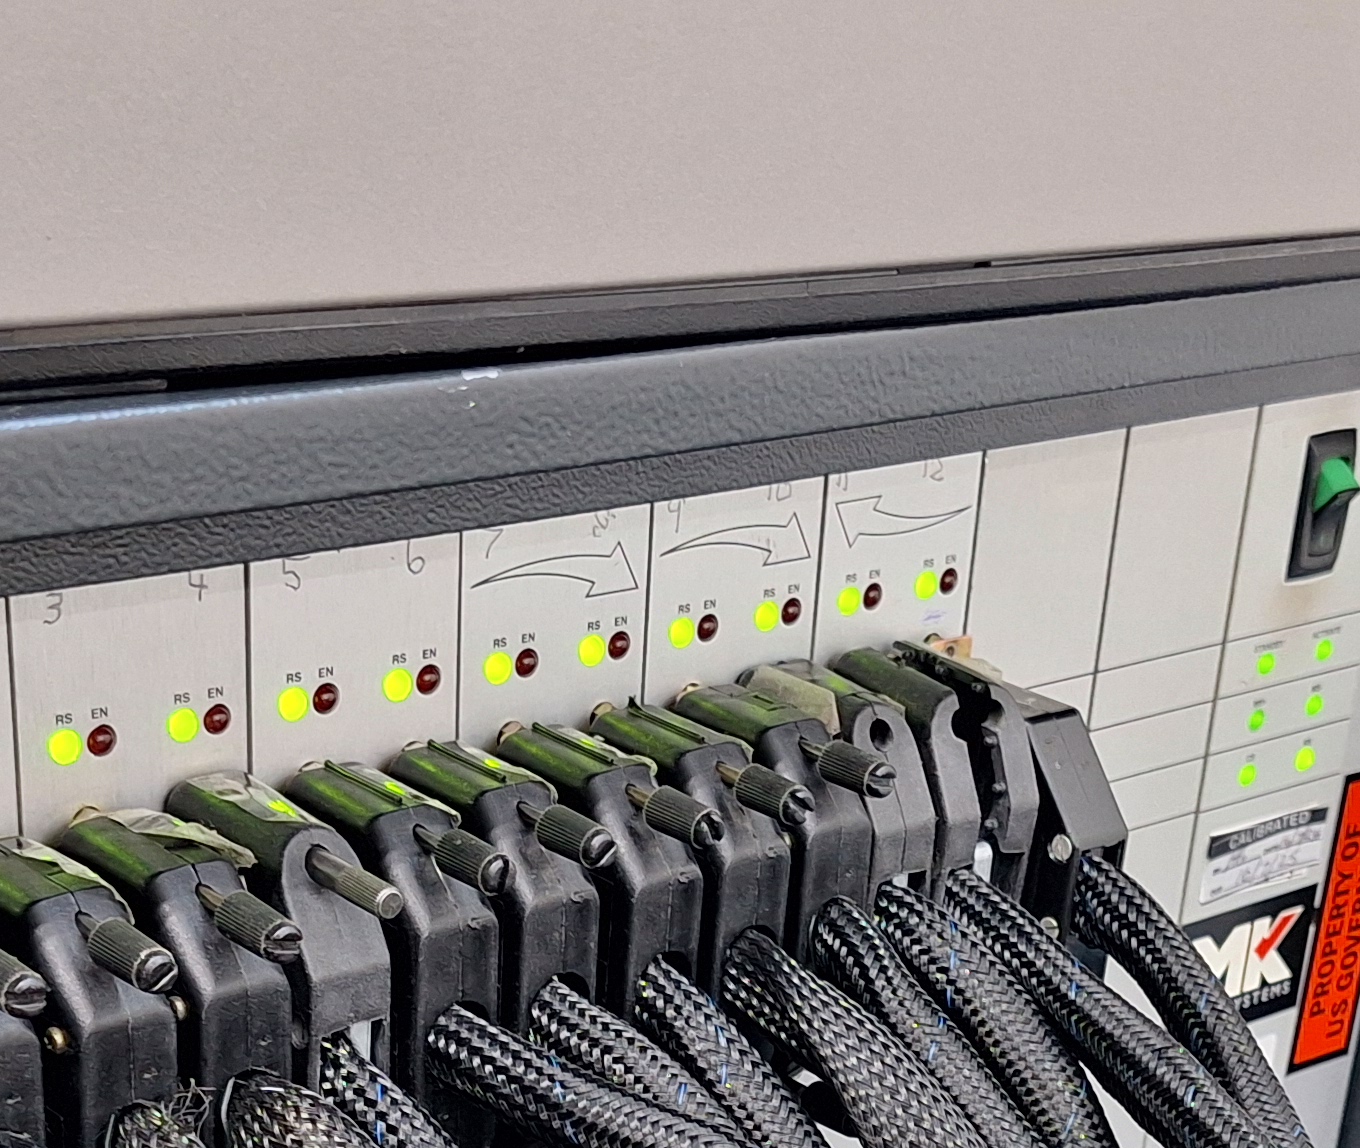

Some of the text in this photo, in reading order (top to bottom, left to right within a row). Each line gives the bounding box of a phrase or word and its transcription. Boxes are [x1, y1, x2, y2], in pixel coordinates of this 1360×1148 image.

[406, 539, 426, 576] 6
[481, 527, 505, 560] 7
[187, 570, 209, 602] 4
[281, 555, 312, 592] 5
[677, 598, 718, 615] RS EN
[762, 583, 802, 600] RS EN
[42, 592, 64, 625] 3
[586, 615, 629, 633] RS EN
[391, 647, 438, 665] RS EN
[492, 631, 537, 650] RS EN
[285, 665, 335, 685] RS EN
[173, 685, 225, 706] RS EN
[55, 706, 109, 727] RS EN
[1228, 809, 1313, 850] CALIBRATED
[1192, 904, 1306, 999] MK
[1309, 870, 1355, 1019] PROPERTY
[1233, 980, 1293, 1010] YSTEMS
[1325, 998, 1349, 1040] US
